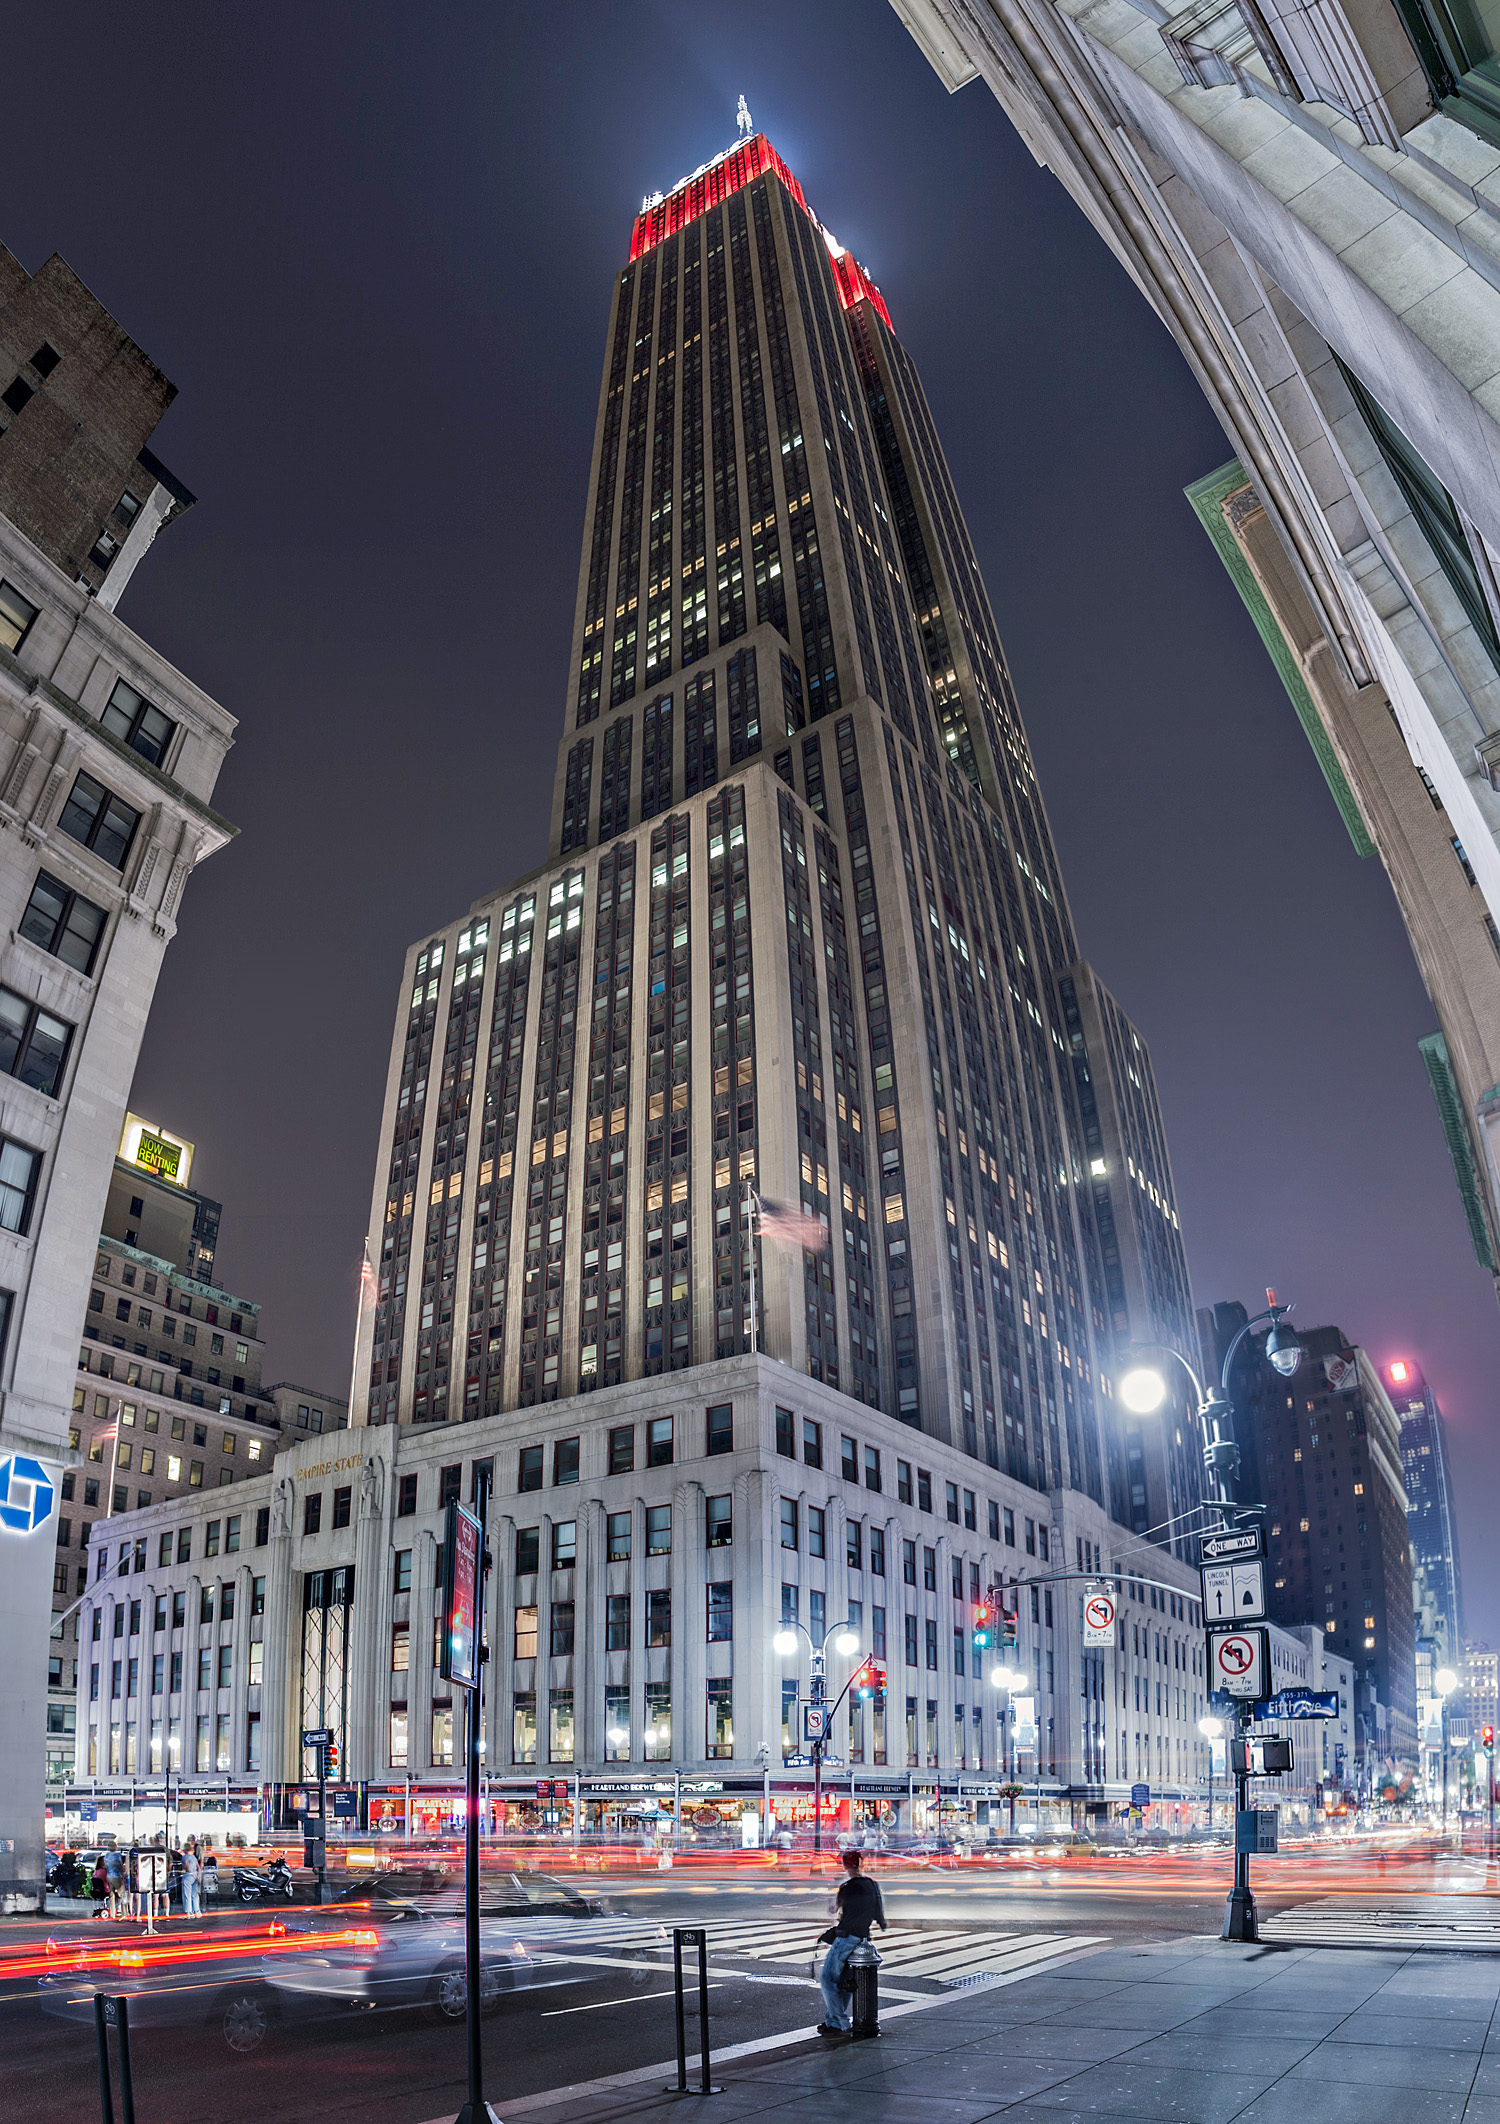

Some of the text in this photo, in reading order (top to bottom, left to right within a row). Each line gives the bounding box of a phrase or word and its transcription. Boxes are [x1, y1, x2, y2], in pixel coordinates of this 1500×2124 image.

[140, 1137, 163, 1155] NOW
[138, 1148, 177, 1175] RENTING
[296, 1453, 364, 1481] EMPIRE STATE
[1210, 1536, 1253, 1552] ONE WAY
[1207, 1571, 1230, 1580] LINCOLN
[1209, 1580, 1229, 1588] TUNNEL
[1221, 1677, 1234, 1686] 8AM
[1240, 1676, 1252, 1685] 7PM
[1268, 1700, 1322, 1715] Fifth Ave
